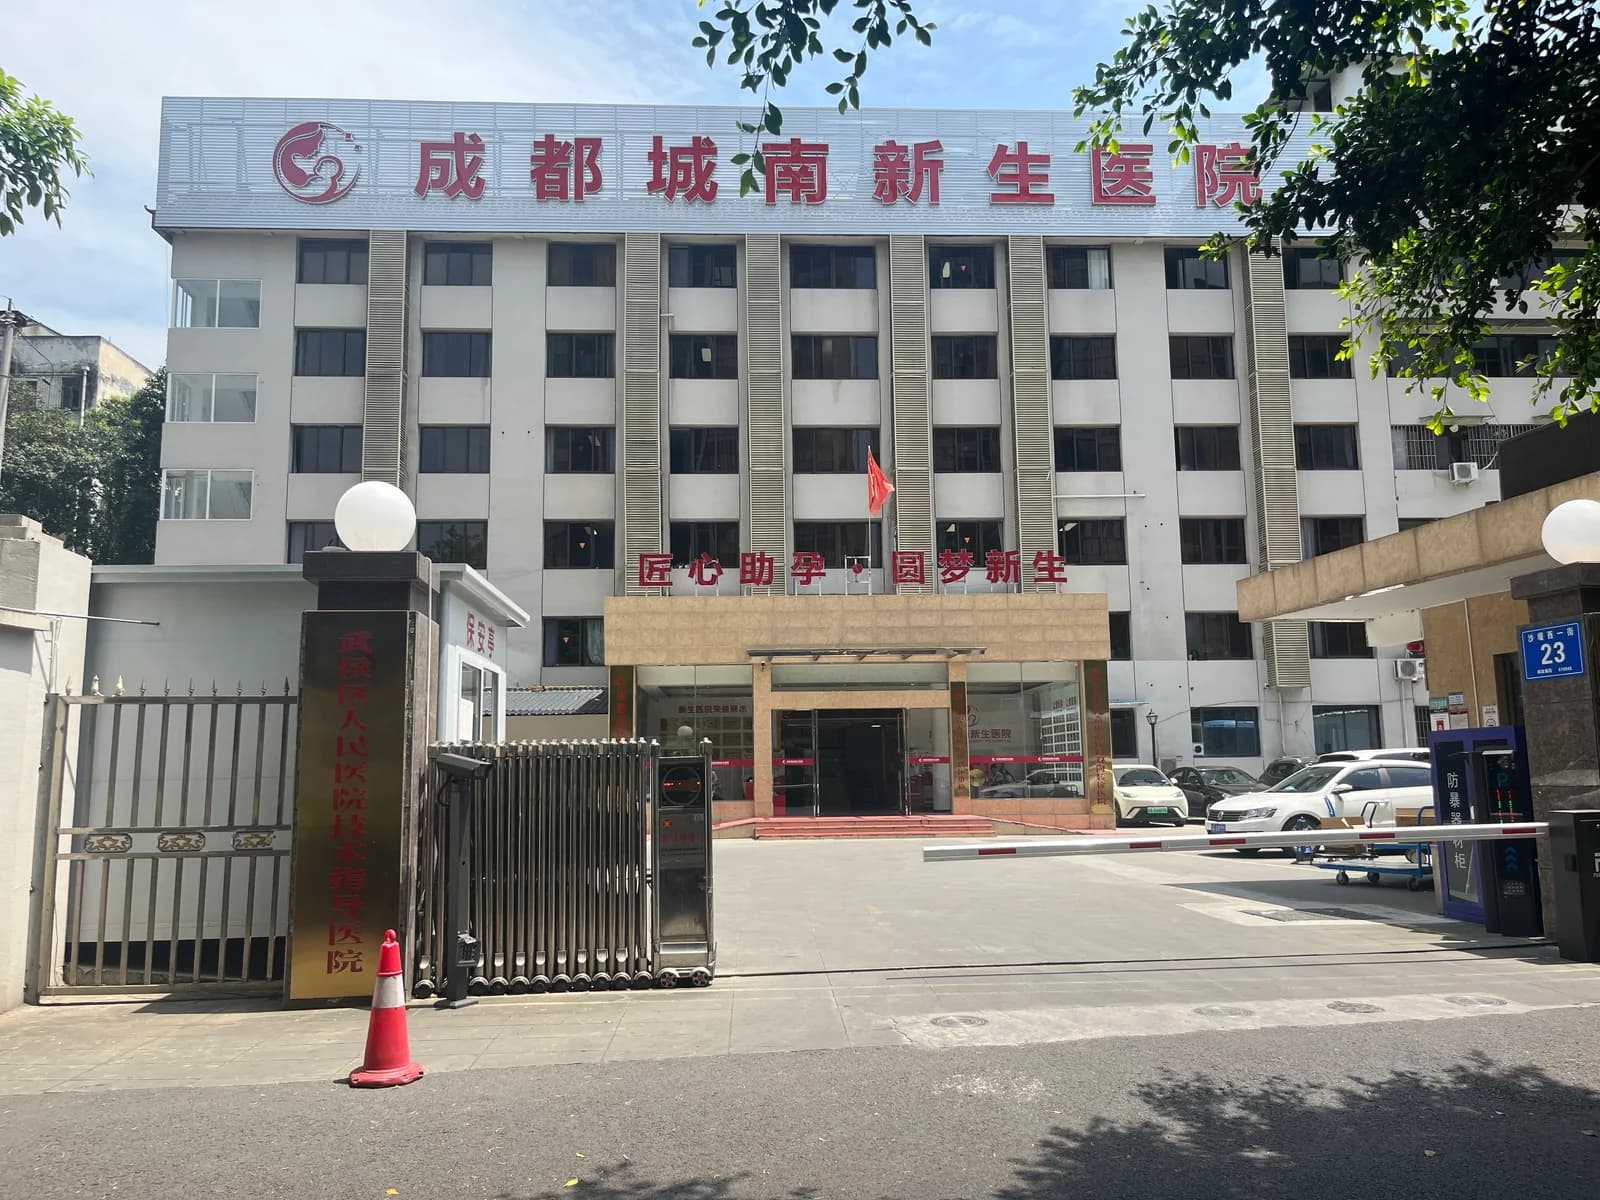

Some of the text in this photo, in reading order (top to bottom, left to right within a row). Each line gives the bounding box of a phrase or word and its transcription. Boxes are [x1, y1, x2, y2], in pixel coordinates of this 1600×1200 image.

[413, 131, 1263, 208] 成都城南新生医院
[466, 611, 495, 659] 保安亭
[1540, 641, 1566, 665] 23
[968, 728, 1012, 739] 新生医院
[326, 630, 375, 975] 武侯区人民医院技术指导医院
